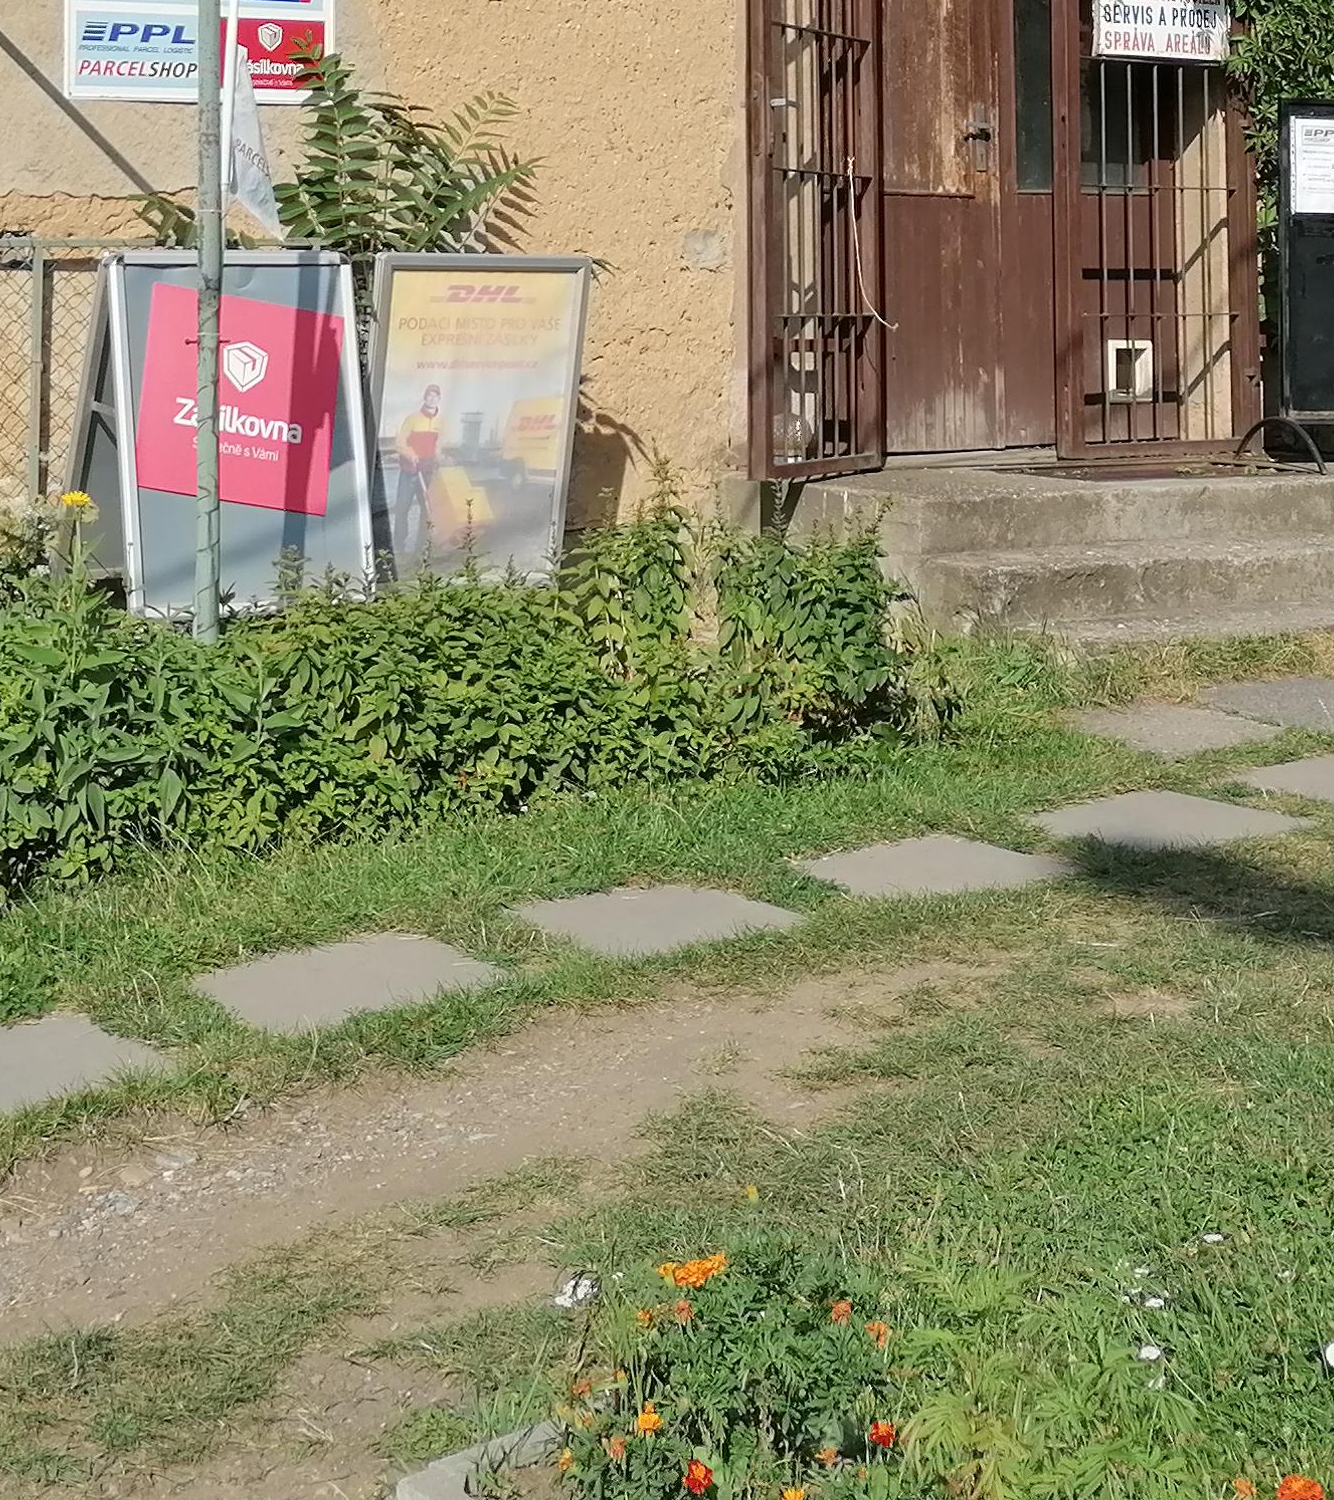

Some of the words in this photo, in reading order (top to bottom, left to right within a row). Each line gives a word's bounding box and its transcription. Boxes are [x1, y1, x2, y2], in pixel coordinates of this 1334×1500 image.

[1103, 4, 1153, 25] SERVIS
[1158, 6, 1167, 26] A
[1172, 7, 1217, 30] PRODEJ
[108, 22, 196, 45] PPL
[1105, 28, 1155, 52] SPRÁVA
[78, 59, 198, 78] PARCELSHOP
[445, 284, 523, 304] DHL
[173, 397, 303, 444] Zilkovna
[244, 448, 251, 457] s
